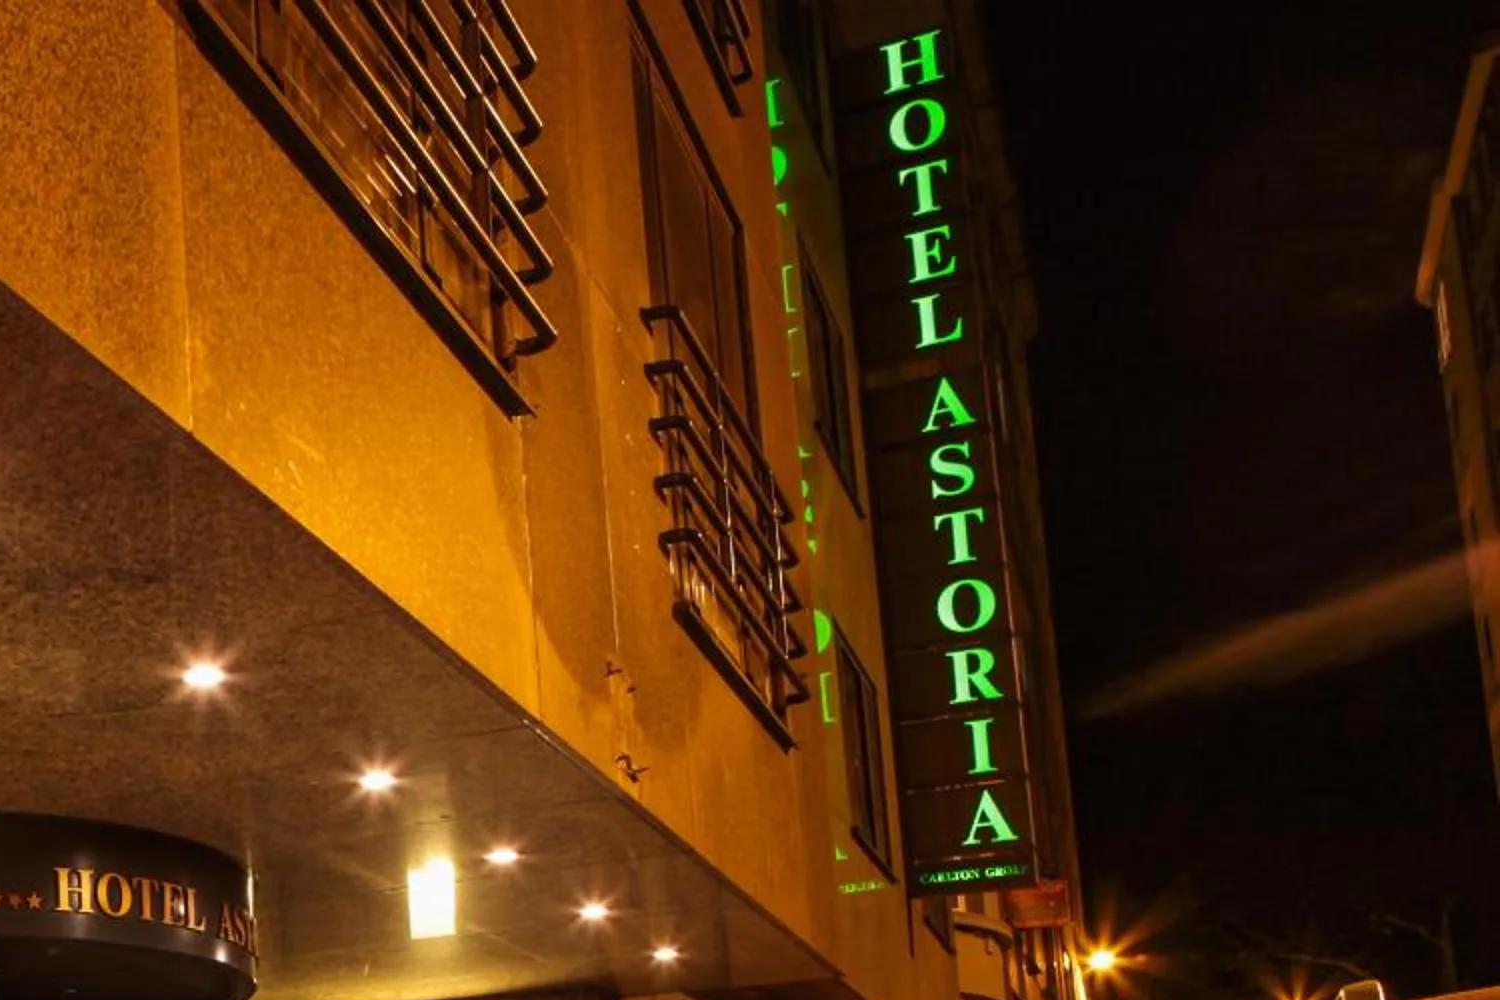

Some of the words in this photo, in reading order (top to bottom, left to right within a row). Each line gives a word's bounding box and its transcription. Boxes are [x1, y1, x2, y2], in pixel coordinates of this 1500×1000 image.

[880, 29, 963, 349] HOTEL
[922, 376, 1019, 846] ASTORIA
[53, 866, 206, 932] HOTEL
